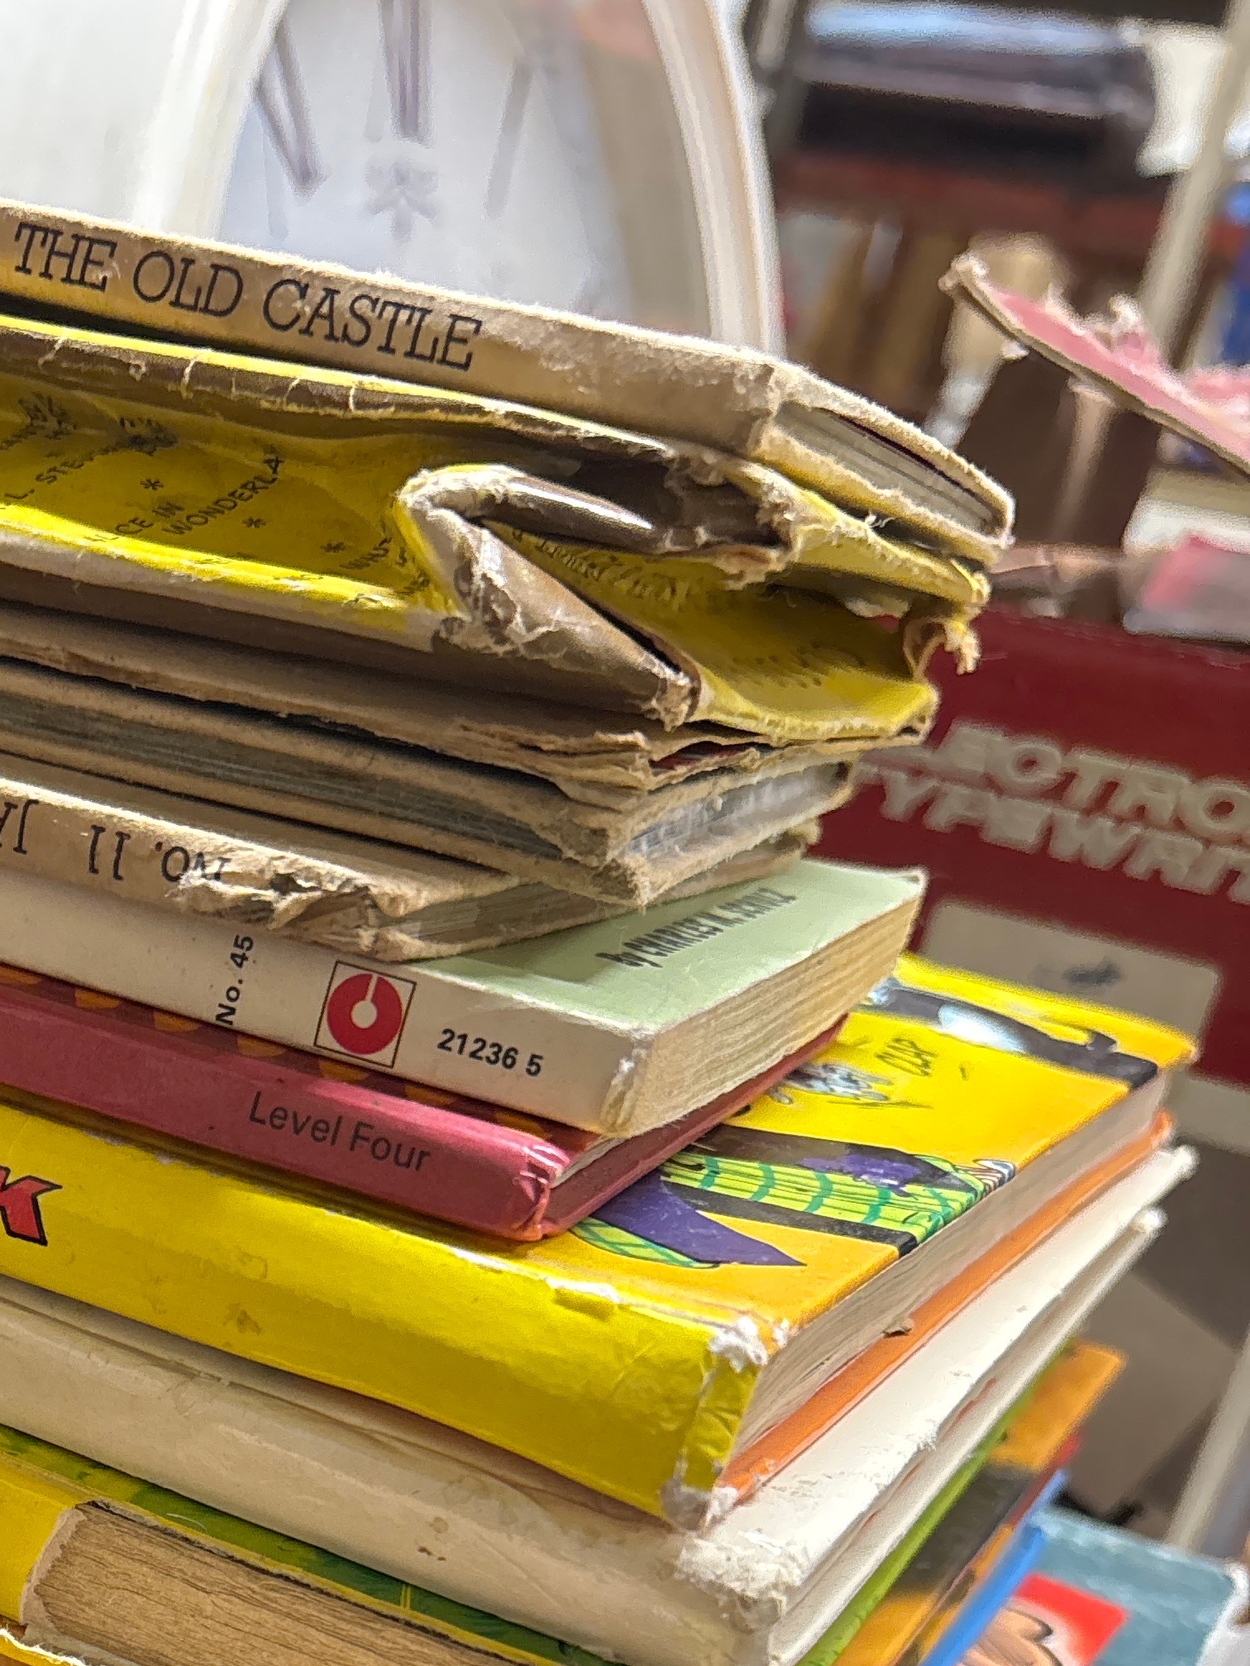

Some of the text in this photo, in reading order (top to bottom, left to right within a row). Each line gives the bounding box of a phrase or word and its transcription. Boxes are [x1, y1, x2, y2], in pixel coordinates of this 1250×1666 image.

[15, 222, 117, 292] THE
[133, 251, 243, 317] OLD
[263, 278, 483, 372] CASTLE
[215, 934, 254, 1026] No. 45
[437, 1028, 544, 1077] 21236 5
[249, 1091, 342, 1149] Level
[350, 1122, 431, 1174] Four
